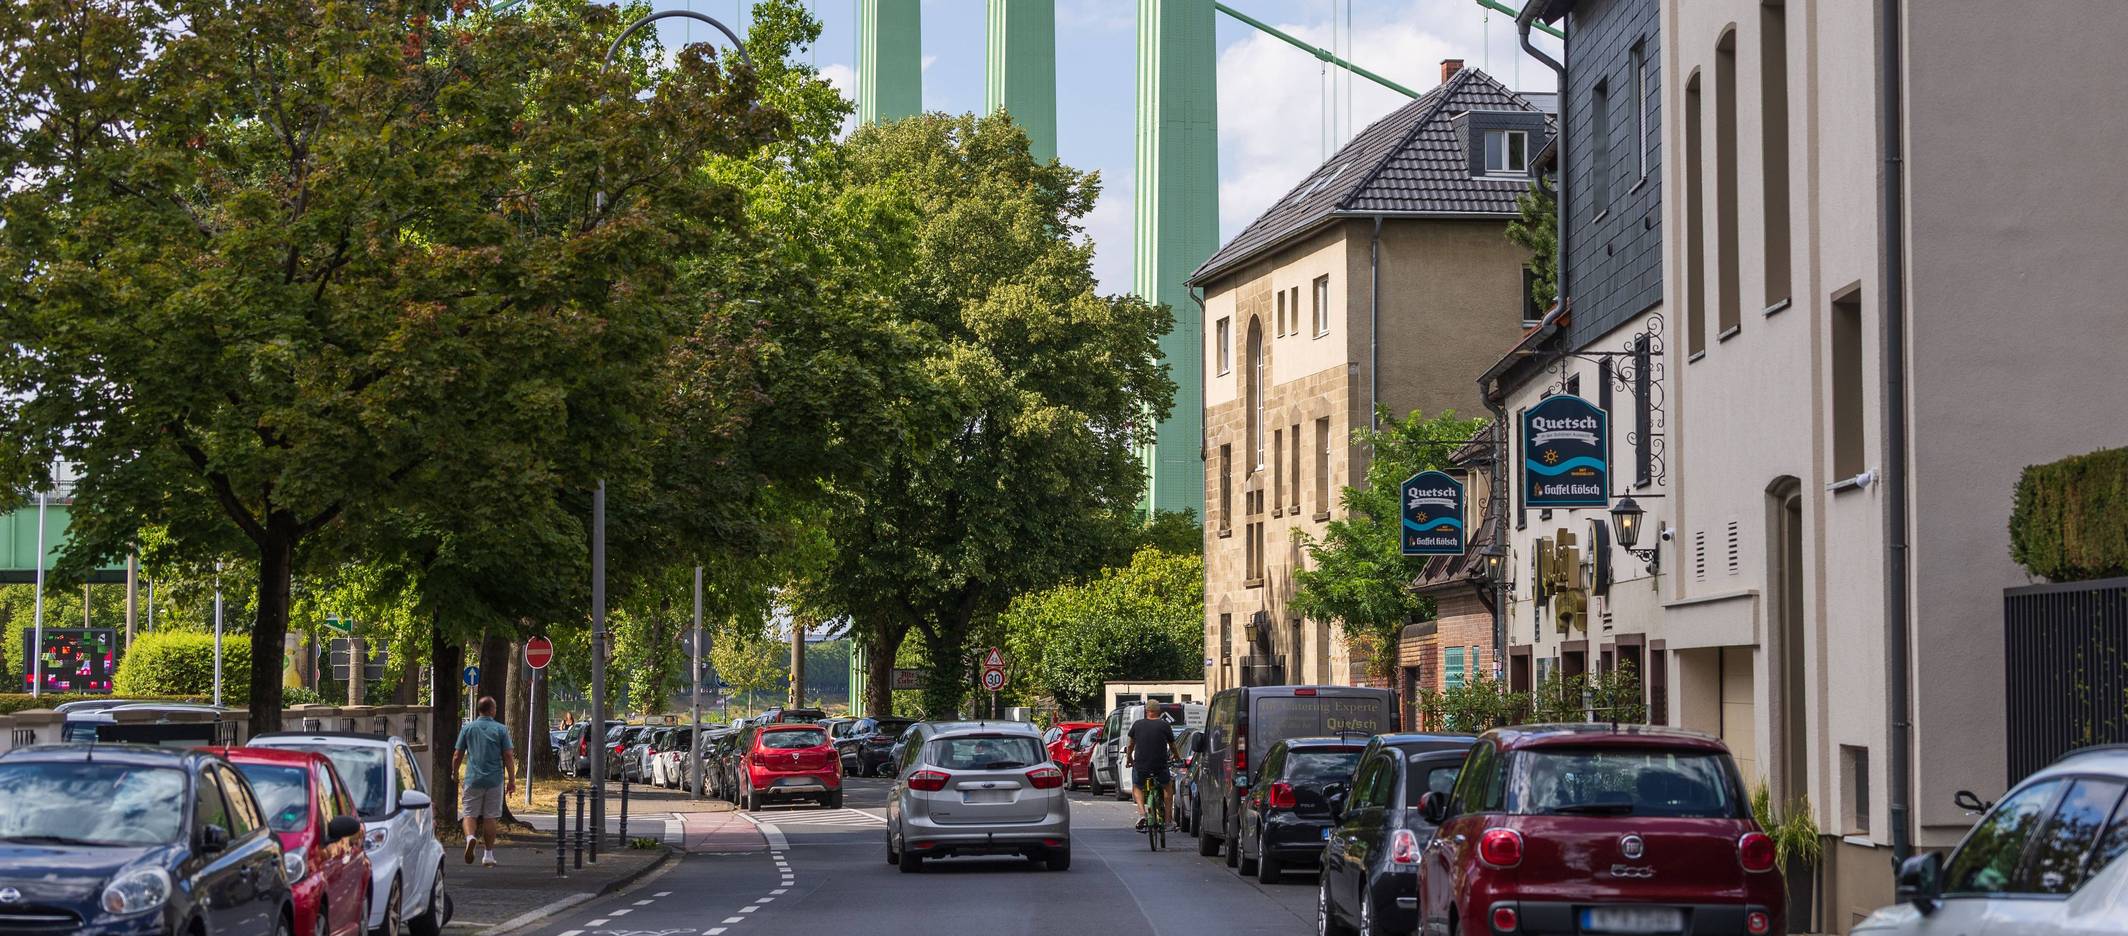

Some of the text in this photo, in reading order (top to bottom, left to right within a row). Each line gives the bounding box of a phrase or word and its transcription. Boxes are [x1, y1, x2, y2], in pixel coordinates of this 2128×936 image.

[1532, 415, 1598, 432] Quetsch
[1408, 487, 1456, 499] Quetsch
[1544, 484, 1600, 496] Gaffel Kölsch
[1416, 537, 1458, 546] Gaffel Kölsch
[987, 674, 1000, 684] 30
